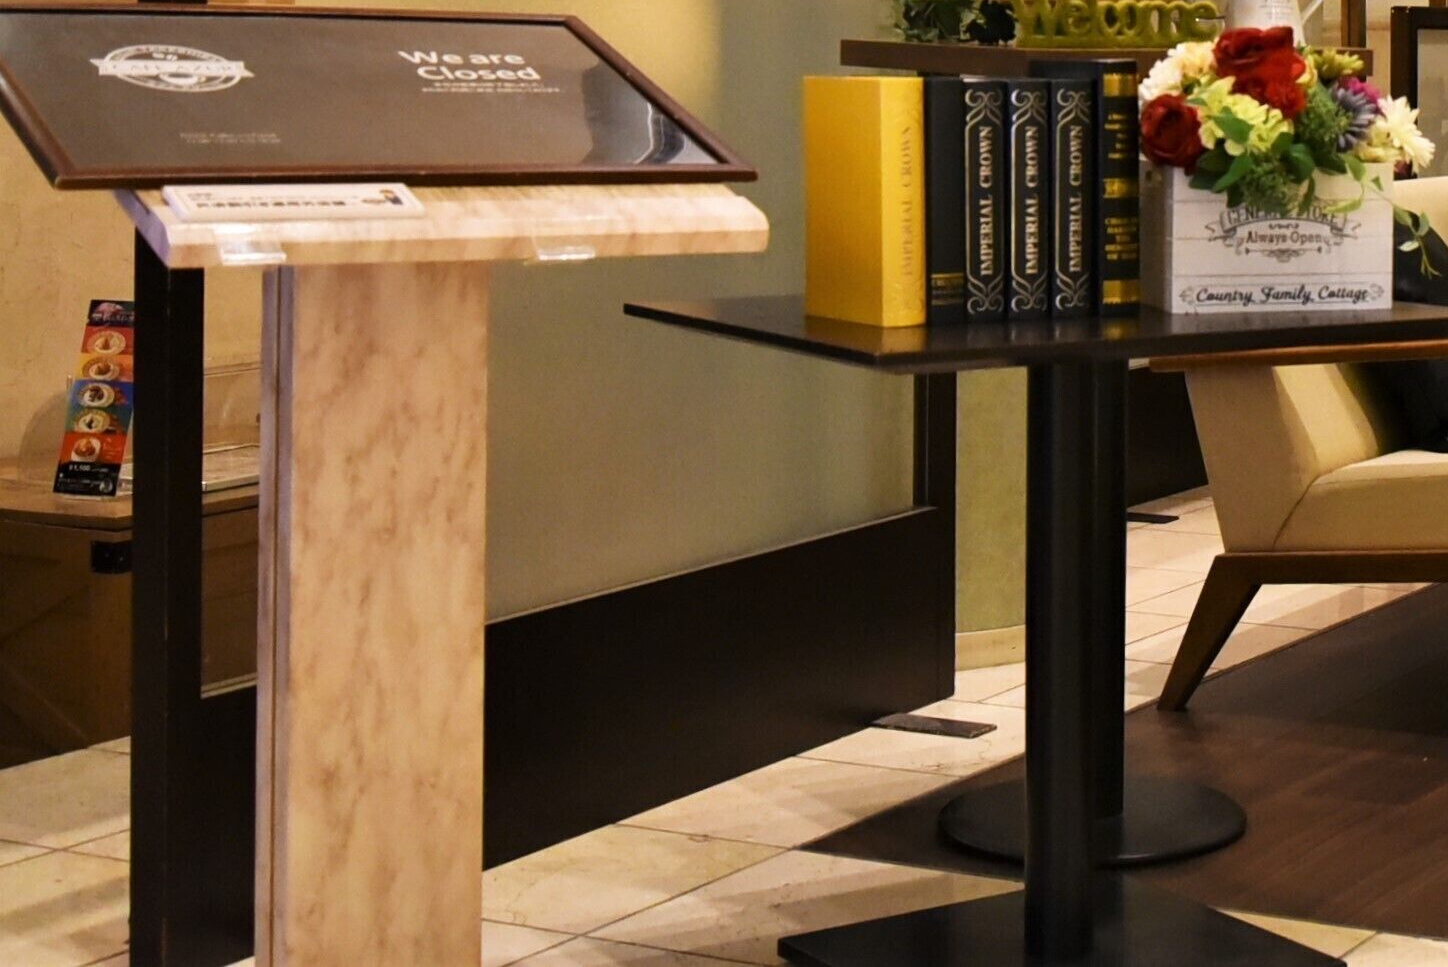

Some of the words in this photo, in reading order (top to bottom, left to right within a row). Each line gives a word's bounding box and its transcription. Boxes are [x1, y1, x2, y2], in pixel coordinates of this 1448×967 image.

[398, 50, 464, 64] We
[469, 53, 526, 65] are
[417, 66, 541, 80] Closed
[900, 125, 914, 188] CROWN
[979, 125, 994, 188] CROWN
[1025, 125, 1039, 187] CROWN
[1069, 125, 1082, 186] CROWN
[979, 194, 994, 276] IMPERIAL
[1025, 194, 1039, 275] IMPERIAL
[1069, 193, 1082, 273] IMPERIAL
[1246, 230, 1287, 245] Always
[1290, 230, 1322, 245] Open
[1196, 287, 1254, 306] Country
[1260, 284, 1314, 305] Family
[1318, 286, 1368, 304] Cottage
